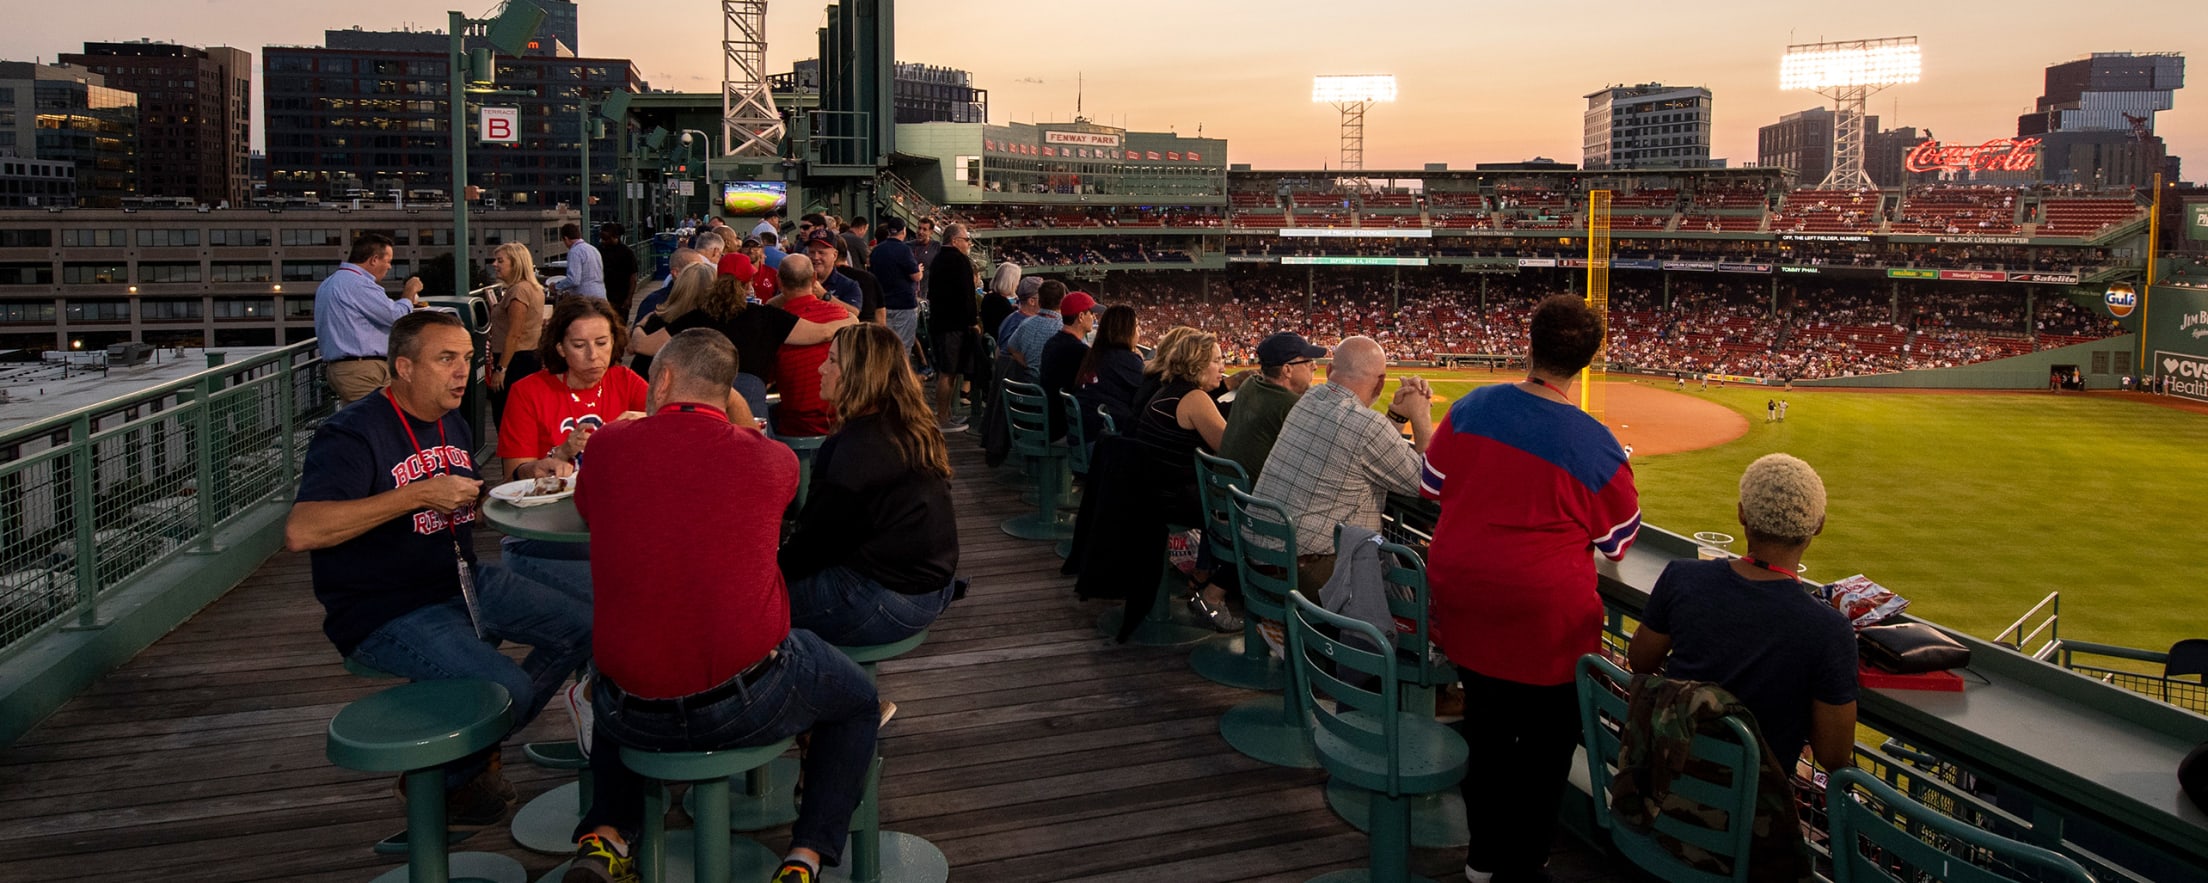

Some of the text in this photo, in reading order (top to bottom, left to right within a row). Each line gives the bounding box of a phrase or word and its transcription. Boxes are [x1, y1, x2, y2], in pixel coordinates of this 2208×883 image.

[489, 118, 511, 139] B
[1050, 133, 1115, 144] FENWAY PARK
[2032, 274, 2076, 283] Safelite
[2105, 292, 2134, 305] Gulf
[2180, 313, 2199, 331] JIM
[391, 445, 473, 489] BOSTON
[1247, 518, 1254, 528] 5
[1325, 642, 1334, 656] 3
